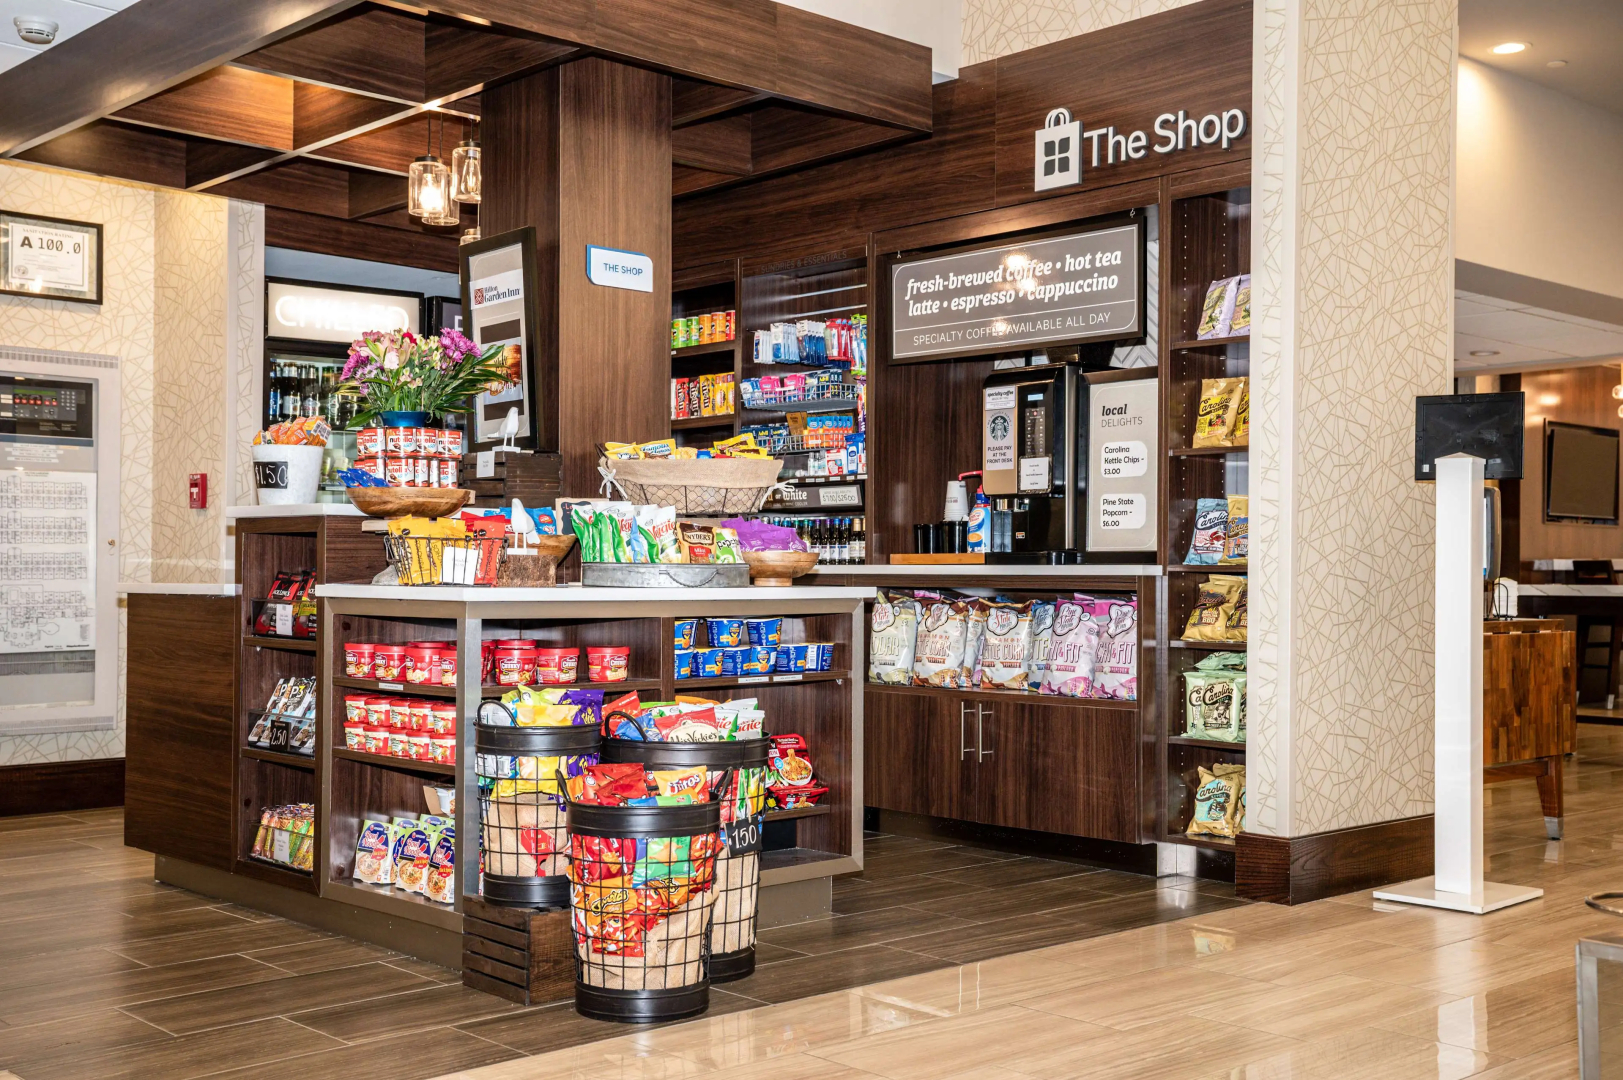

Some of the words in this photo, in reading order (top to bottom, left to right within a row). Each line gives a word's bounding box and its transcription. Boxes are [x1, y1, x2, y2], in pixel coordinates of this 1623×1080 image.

[1083, 126, 1148, 168] The
[1153, 108, 1247, 153] Shop
[20, 235, 33, 249] A
[38, 237, 81, 254] 100.0
[603, 262, 619, 273] THE
[621, 265, 643, 277] SHOP
[905, 265, 1003, 300] fresh-brewed
[1005, 258, 1052, 283] coffee
[1064, 254, 1092, 272] hot
[1095, 250, 1122, 267] tea
[484, 284, 498, 293] Hilton
[484, 289, 507, 303] Garden
[507, 287, 520, 298] Inn
[908, 299, 940, 317] latte
[950, 289, 1015, 313] espresso
[1027, 274, 1119, 302] cappuccino
[913, 330, 964, 346] SPECIALTY
[1006, 318, 1062, 335] AVAILABLE
[1065, 315, 1086, 328] ALL
[1089, 311, 1111, 325] DAY
[1101, 403, 1128, 417] local
[1101, 416, 1143, 428] DELIGHTS
[1104, 446, 1130, 454] Carolina
[1104, 456, 1122, 464] Kettle
[1123, 455, 1140, 465] Chips
[783, 490, 808, 501] white
[1102, 498, 1117, 506] Pine
[1117, 498, 1134, 506] State
[1102, 509, 1128, 518] Popcorn
[1195, 511, 1228, 530] Carolin
[1102, 520, 1120, 528] $6.00
[1063, 642, 1083, 664] FIT
[1116, 642, 1136, 665] FIT
[290, 685, 306, 698] P3
[1203, 684, 1234, 706] Carolina
